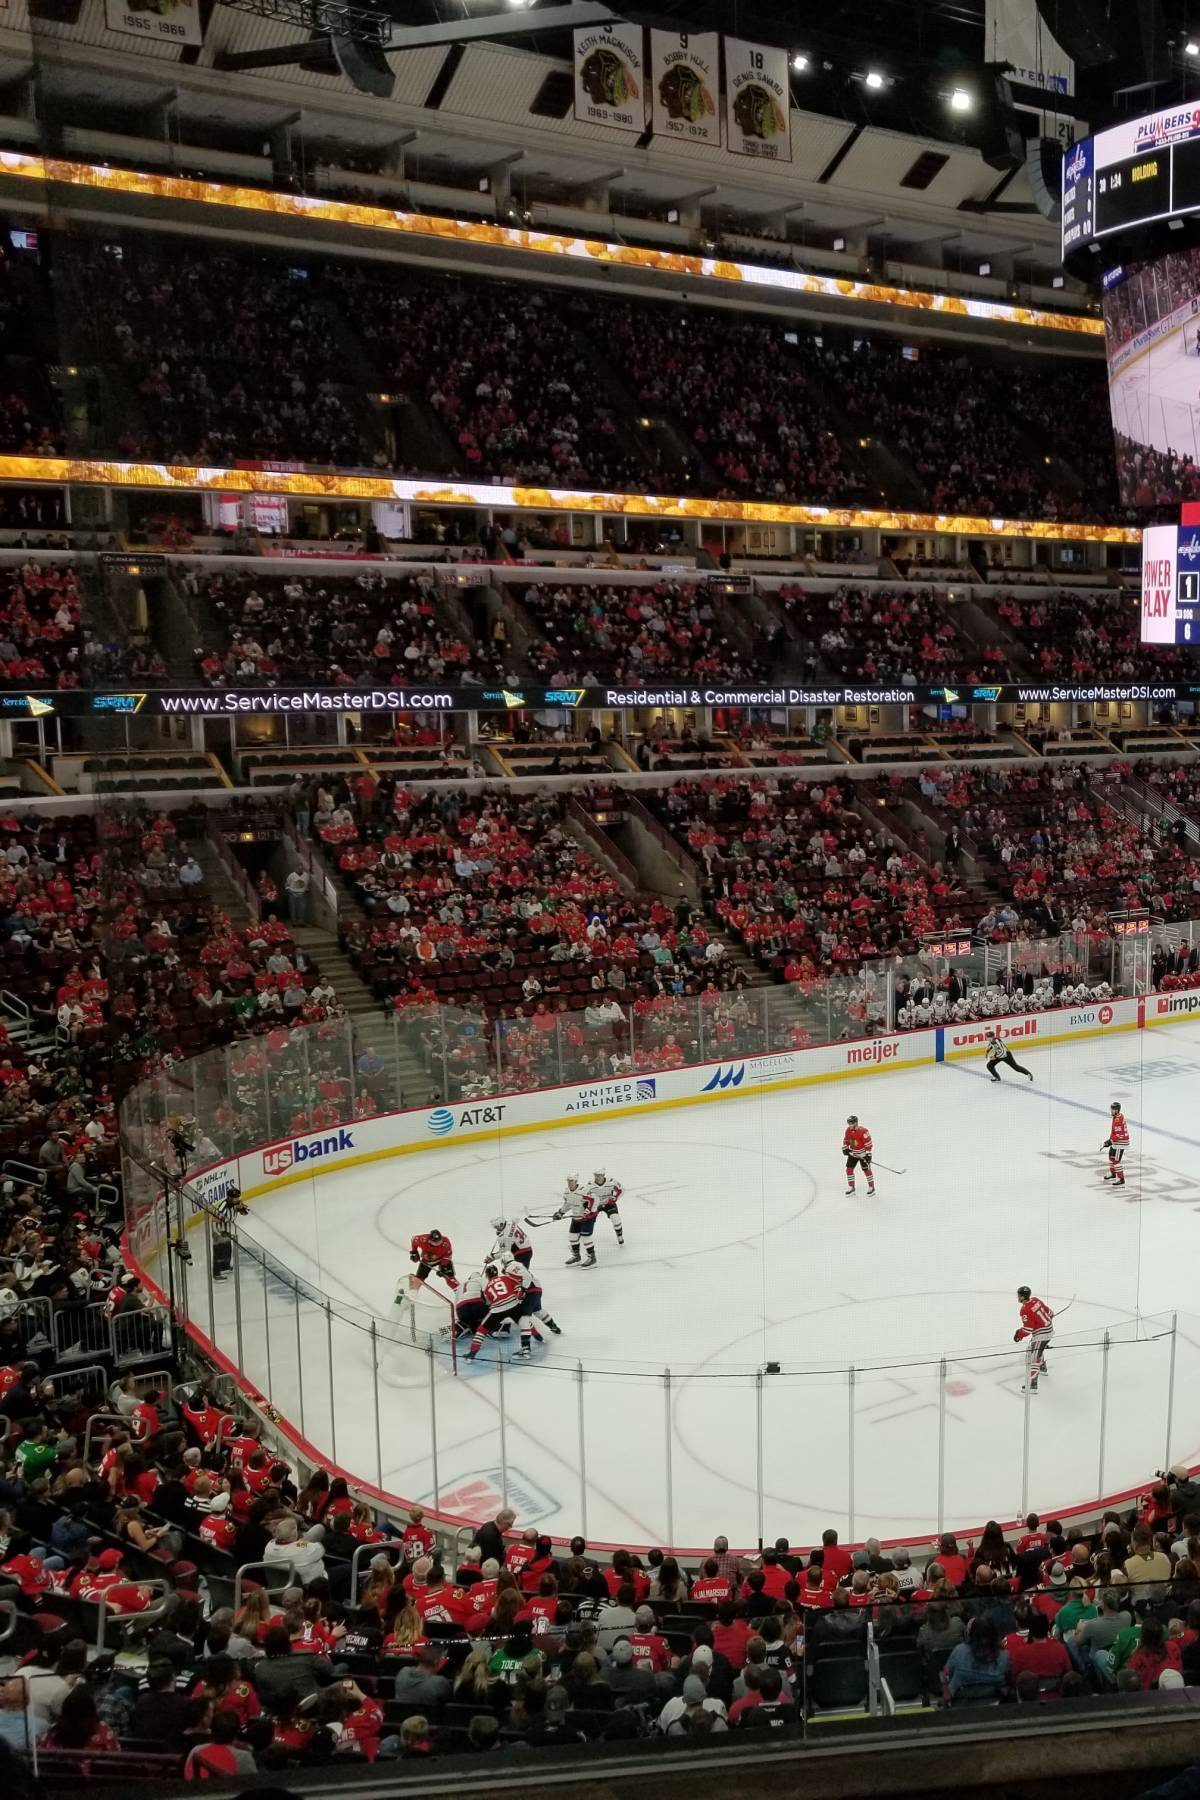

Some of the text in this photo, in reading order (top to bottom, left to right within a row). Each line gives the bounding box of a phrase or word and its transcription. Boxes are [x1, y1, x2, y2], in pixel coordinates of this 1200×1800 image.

[599, 31, 640, 68] MAGNUSON
[663, 52, 688, 66] BOBBY
[750, 51, 763, 69] 18
[756, 72, 783, 96] SAVARD
[1131, 161, 1158, 182] HOLDING
[1144, 559, 1171, 587] POWER
[1185, 578, 1191, 599] 1
[1143, 590, 1171, 618] PLAY
[1184, 624, 1191, 640] 6
[162, 691, 452, 711] www.ServiceMasterDSI.com
[607, 690, 687, 705] Residential
[691, 691, 701, 703] &
[705, 689, 785, 703] Commercial
[790, 689, 841, 703] Disaster
[844, 689, 914, 702] Restoration
[1018, 686, 1175, 701] www.ServiceMasterDSI.com
[1070, 1012, 1095, 1025] BMO
[953, 1019, 1037, 1046] uniball
[848, 1040, 899, 1063] meijer
[579, 1084, 632, 1099] UNITED
[565, 1094, 632, 1111] AIRLINES
[460, 1105, 506, 1127] AT&T
[264, 1129, 355, 1171] us bank
[487, 1280, 508, 1302] 19
[511, 1555, 527, 1565] TOEWS
[532, 1607, 546, 1615] KANE
